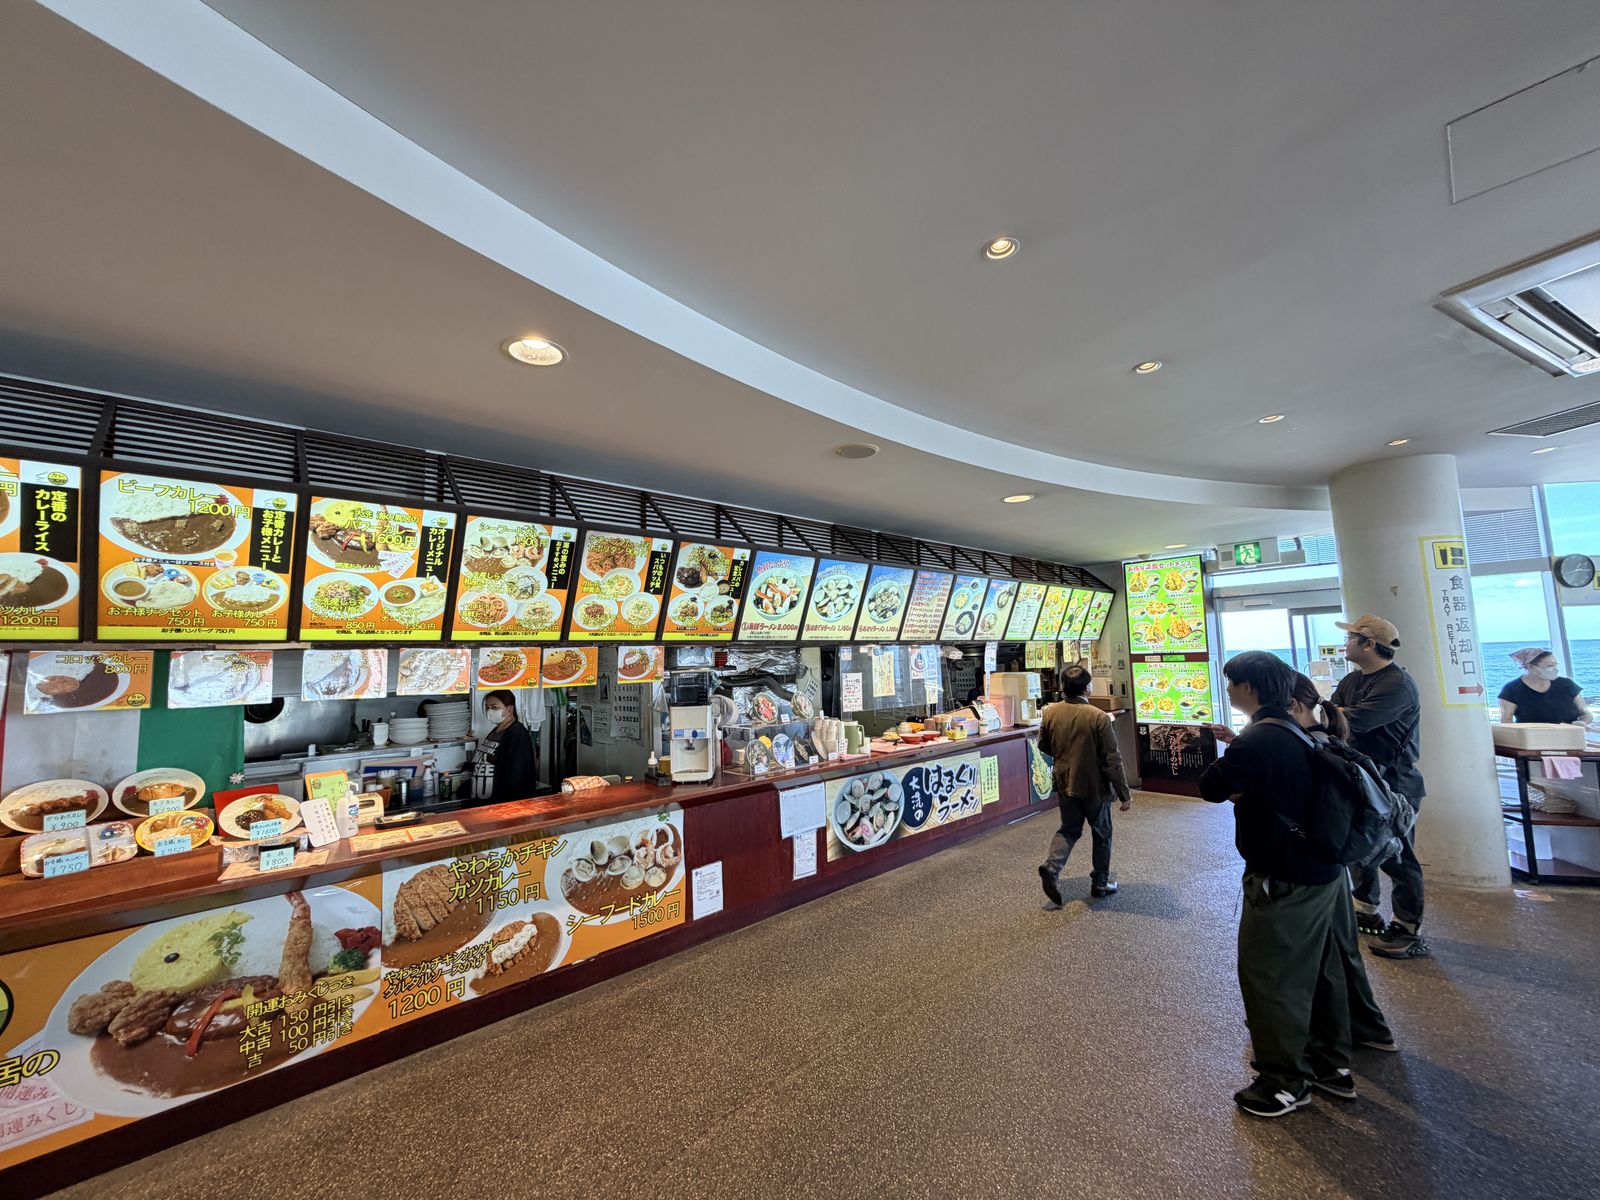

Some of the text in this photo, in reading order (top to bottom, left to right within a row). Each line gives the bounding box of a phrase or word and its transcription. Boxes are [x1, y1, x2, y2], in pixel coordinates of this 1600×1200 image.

[51, 490, 67, 522] 定番の
[118, 478, 220, 500] ビーフカレー
[35, 489, 51, 552] カレーライス
[271, 509, 286, 563] 定番カレーと
[344, 520, 418, 536] パワーカレー
[259, 509, 274, 571] お子様メニュー
[425, 527, 439, 580] カレーメニュー
[434, 528, 447, 566] オリジナル
[0, 605, 59, 615] ツカレー
[107, 607, 203, 618] お子様ナンセット
[1441, 589, 1459, 666] TRAY RETURN
[1449, 575, 1476, 675] 食器返却口
[55, 654, 149, 664] コロッケカレー
[923, 762, 980, 796] はまぐり
[936, 789, 980, 824] ラーメン
[448, 838, 568, 880] やわらかチキン
[448, 870, 532, 904] カツカレー
[565, 889, 682, 936] シーフードカレー
[383, 938, 510, 983] やわらかチキンカツカレー
[383, 956, 486, 1000] タルタルソースかけ
[245, 975, 354, 1019] 開運おみくじつき
[238, 1019, 273, 1044] 大吉
[238, 1034, 272, 1057] 中吉
[247, 1052, 263, 1069] 吉
